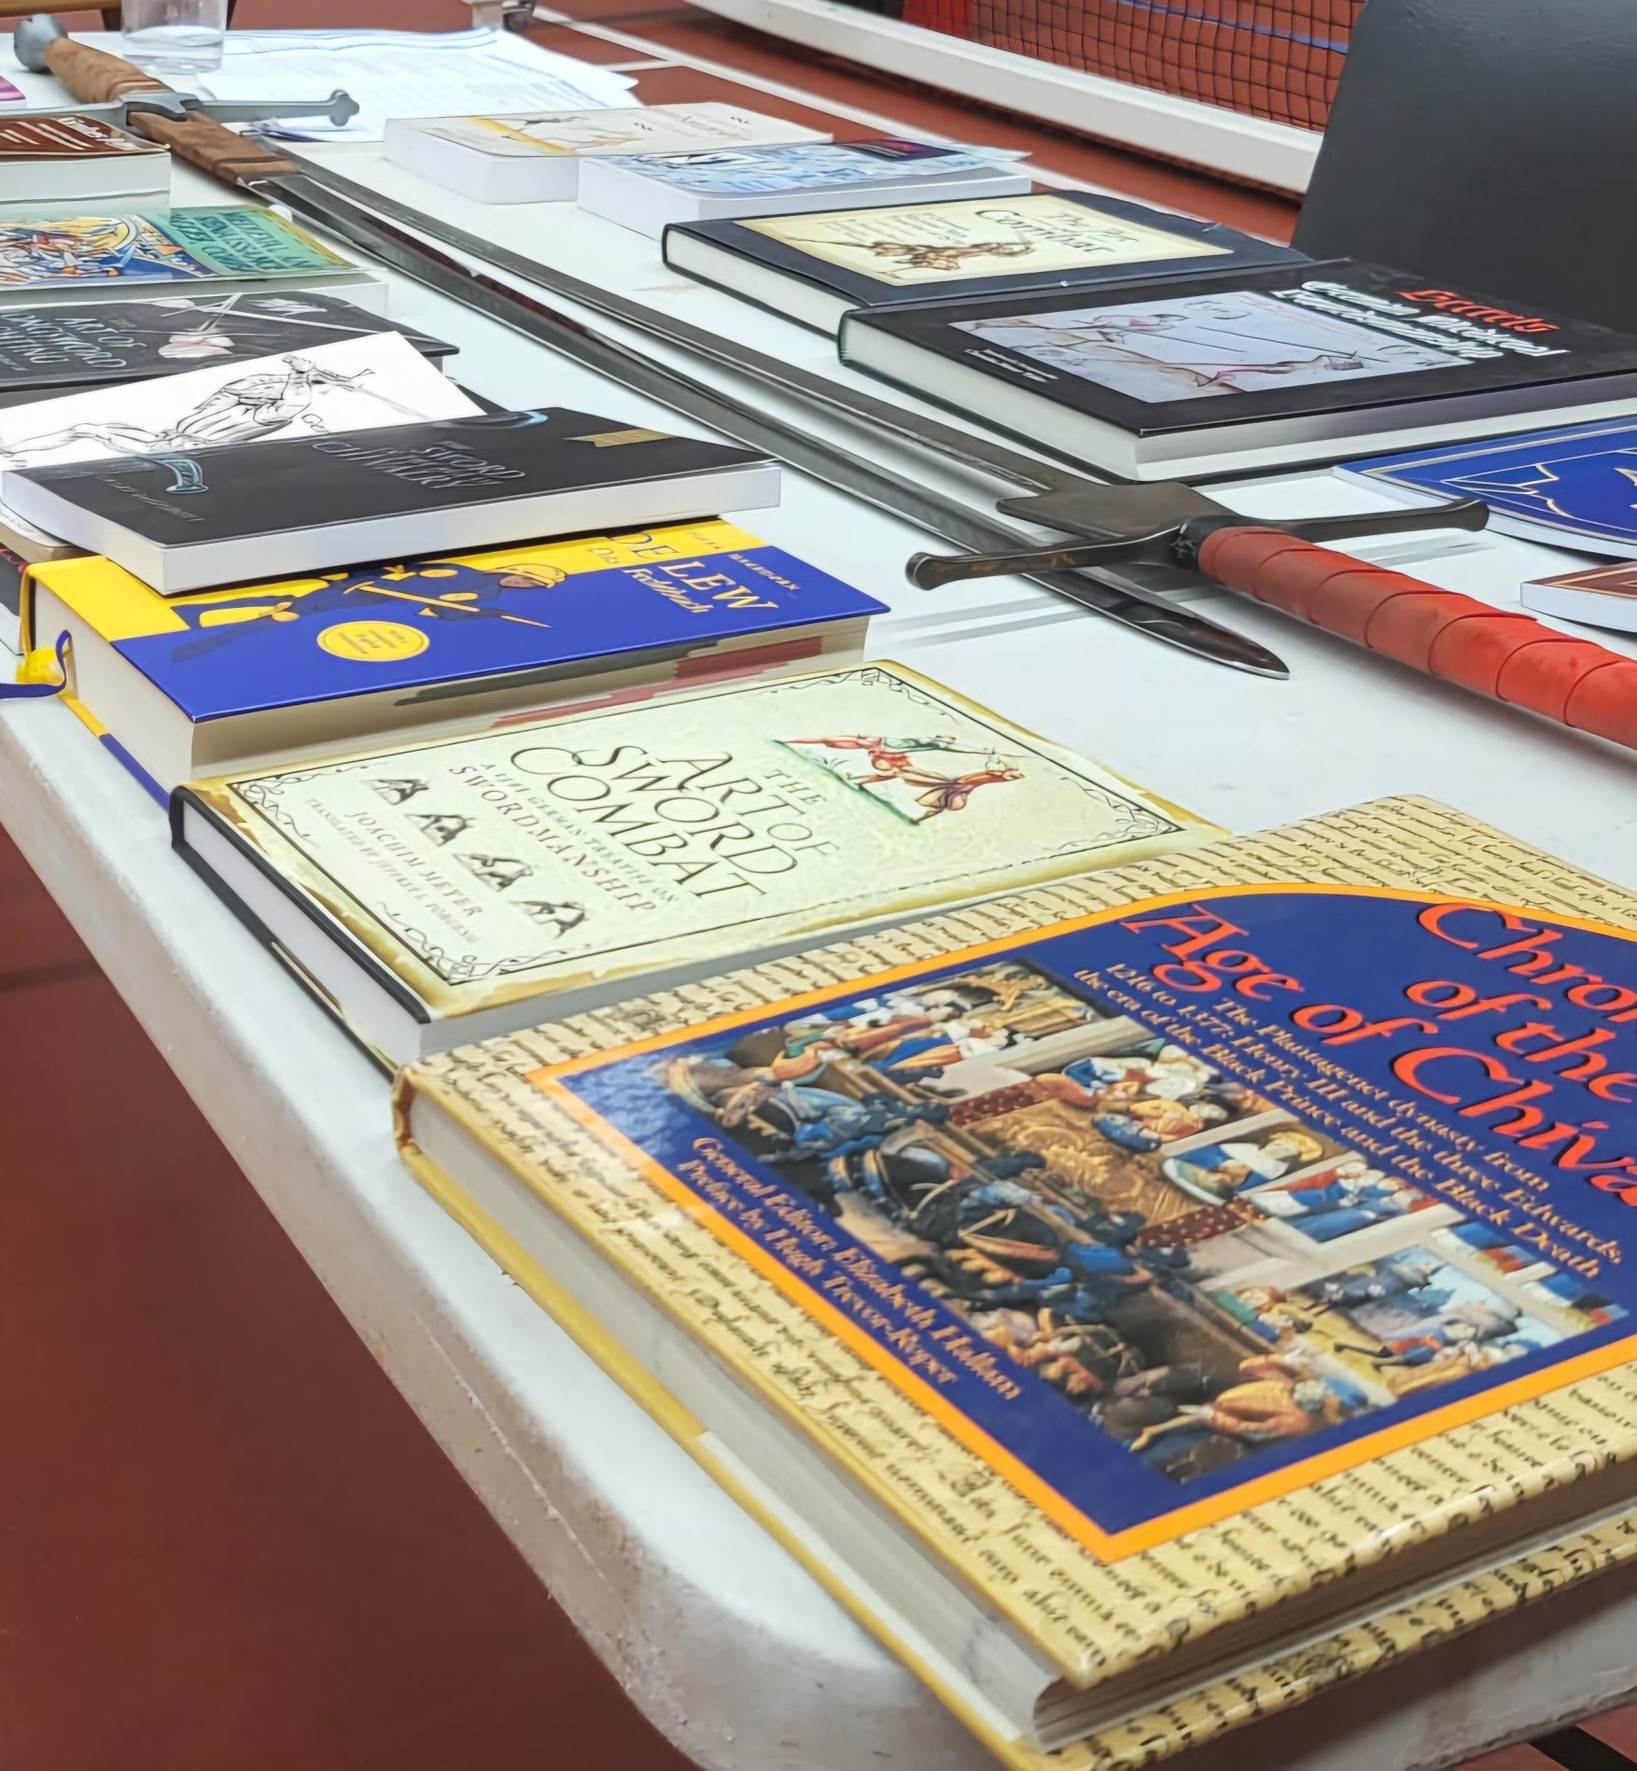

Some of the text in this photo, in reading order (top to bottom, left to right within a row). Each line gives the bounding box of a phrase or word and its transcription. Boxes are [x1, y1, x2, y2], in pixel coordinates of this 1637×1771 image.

[657, 560, 780, 609] LEW
[449, 765, 657, 911] SWORDMANSHIP
[510, 746, 768, 898] COMBAT
[572, 745, 798, 874] SWORD
[656, 750, 840, 856] ART OF
[764, 768, 827, 805] THE
[1120, 903, 1306, 1002] Age
[1292, 1004, 1439, 1046] of
[1406, 980, 1637, 1102] of the
[1074, 969, 1600, 1278] the era of the Black Prince and the Black Death
[1151, 991, 1177, 1006] to
[1230, 1035, 1308, 1079] Henry
[1341, 1100, 1398, 1128] and
[1390, 1126, 1433, 1151] the
[1433, 1151, 1501, 1190] three
[1213, 998, 1550, 1192] The Plantagenet dynasty from
[693, 1137, 778, 1198] General
[833, 1246, 936, 1330] Elizabeth
[931, 1324, 1023, 1400] Hallam
[764, 1228, 826, 1278] Hugh
